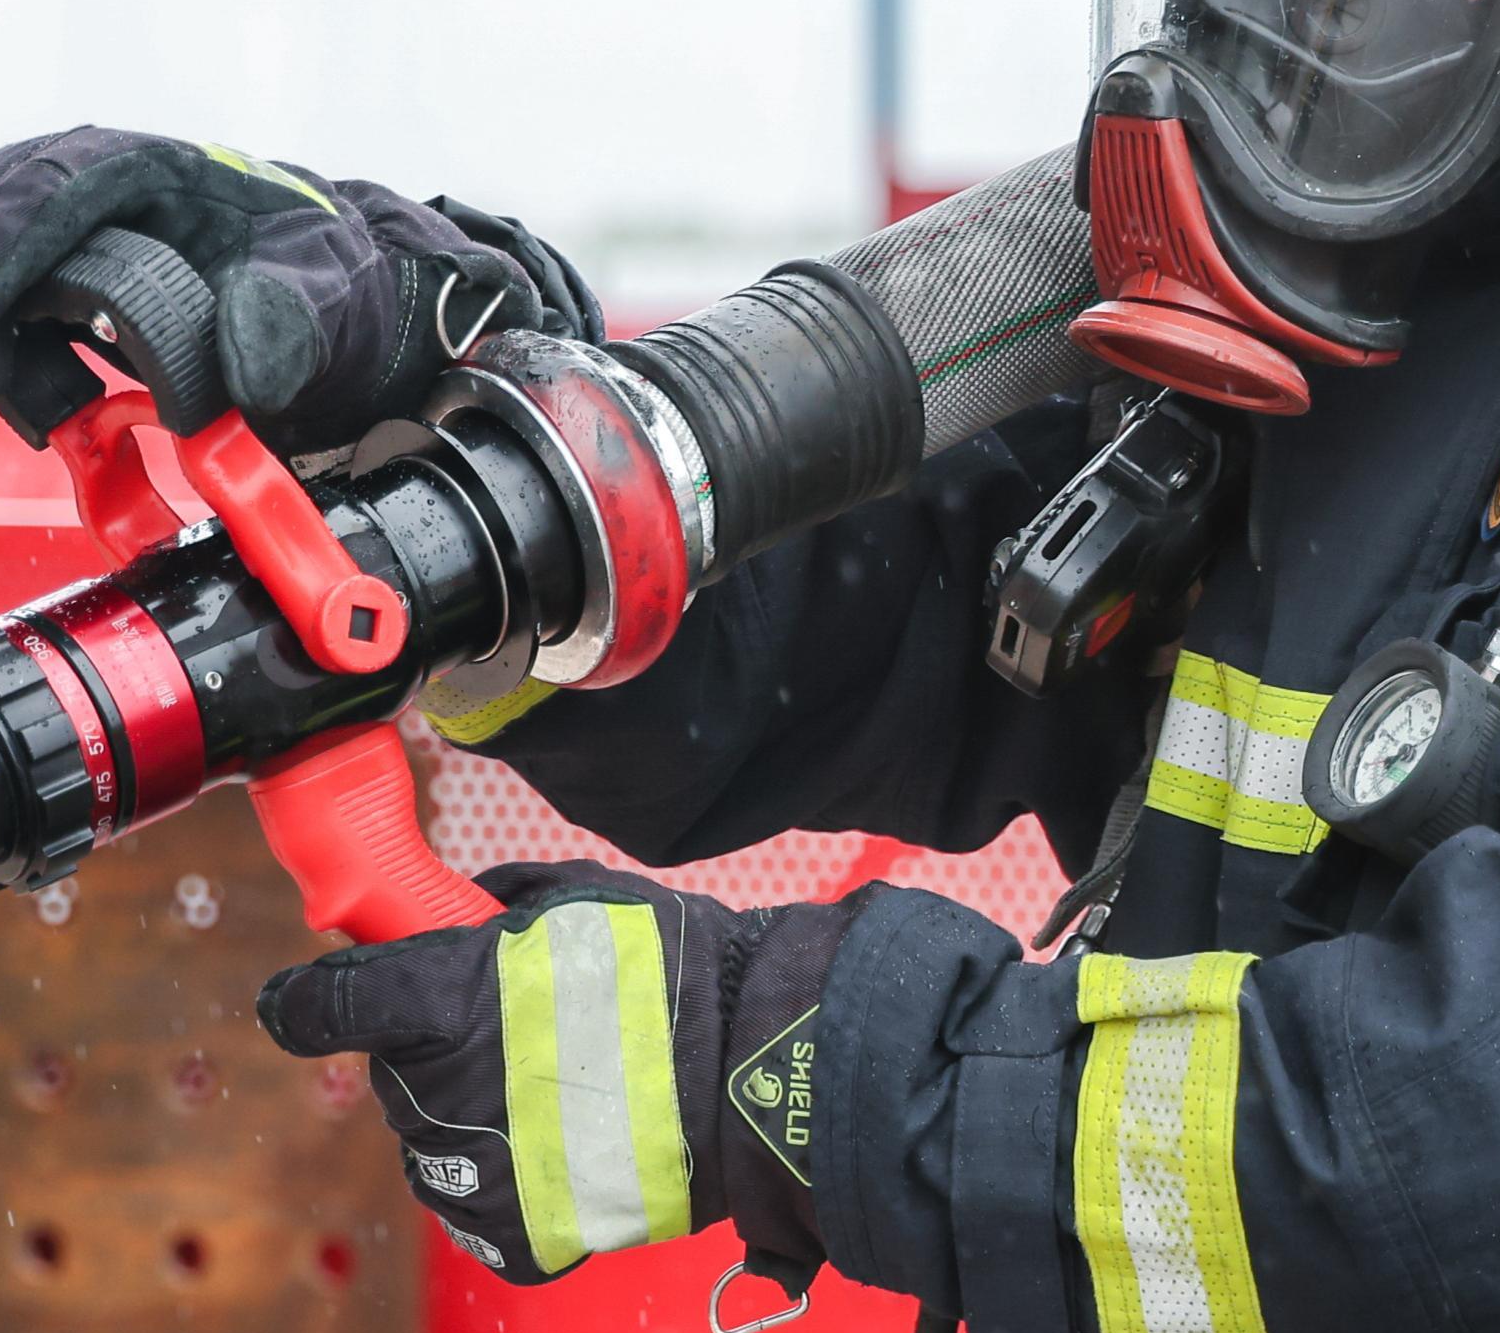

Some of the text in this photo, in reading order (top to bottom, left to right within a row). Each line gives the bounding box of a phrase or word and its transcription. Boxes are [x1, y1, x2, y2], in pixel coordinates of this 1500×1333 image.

[23, 634, 54, 661] 950
[80, 720, 106, 757] 570
[95, 770, 114, 804] 475
[784, 1039, 816, 1147] SHIELD
